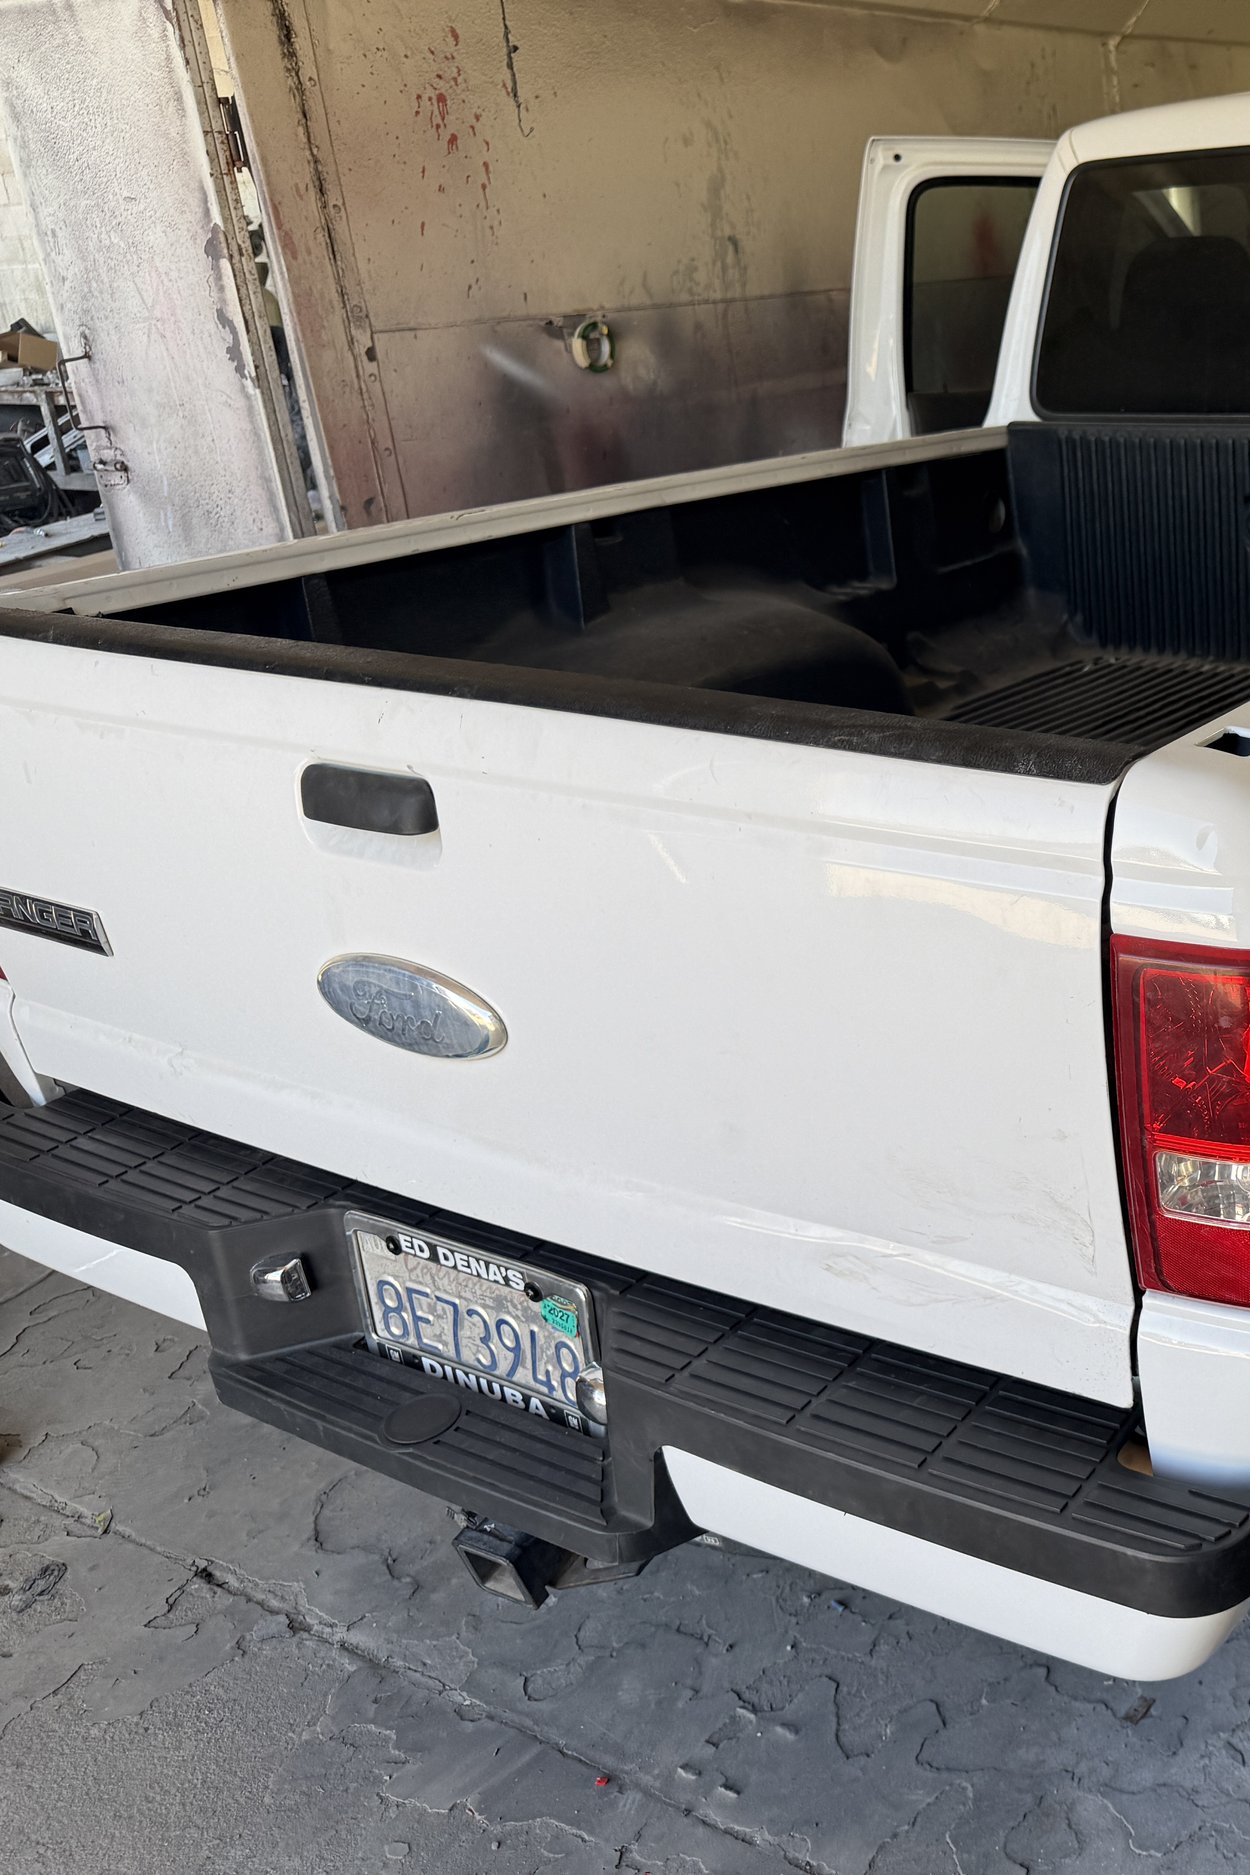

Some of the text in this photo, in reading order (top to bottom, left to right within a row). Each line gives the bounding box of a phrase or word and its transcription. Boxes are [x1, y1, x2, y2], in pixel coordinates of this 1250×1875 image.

[0, 893, 97, 941] ANGER
[351, 977, 445, 1043] Ford
[398, 1233, 431, 1260] ED
[436, 1245, 526, 1292] DENA'S
[376, 1278, 581, 1408] 8E73948
[548, 1307, 570, 1324] 2027
[421, 1356, 550, 1421] DINUBA
